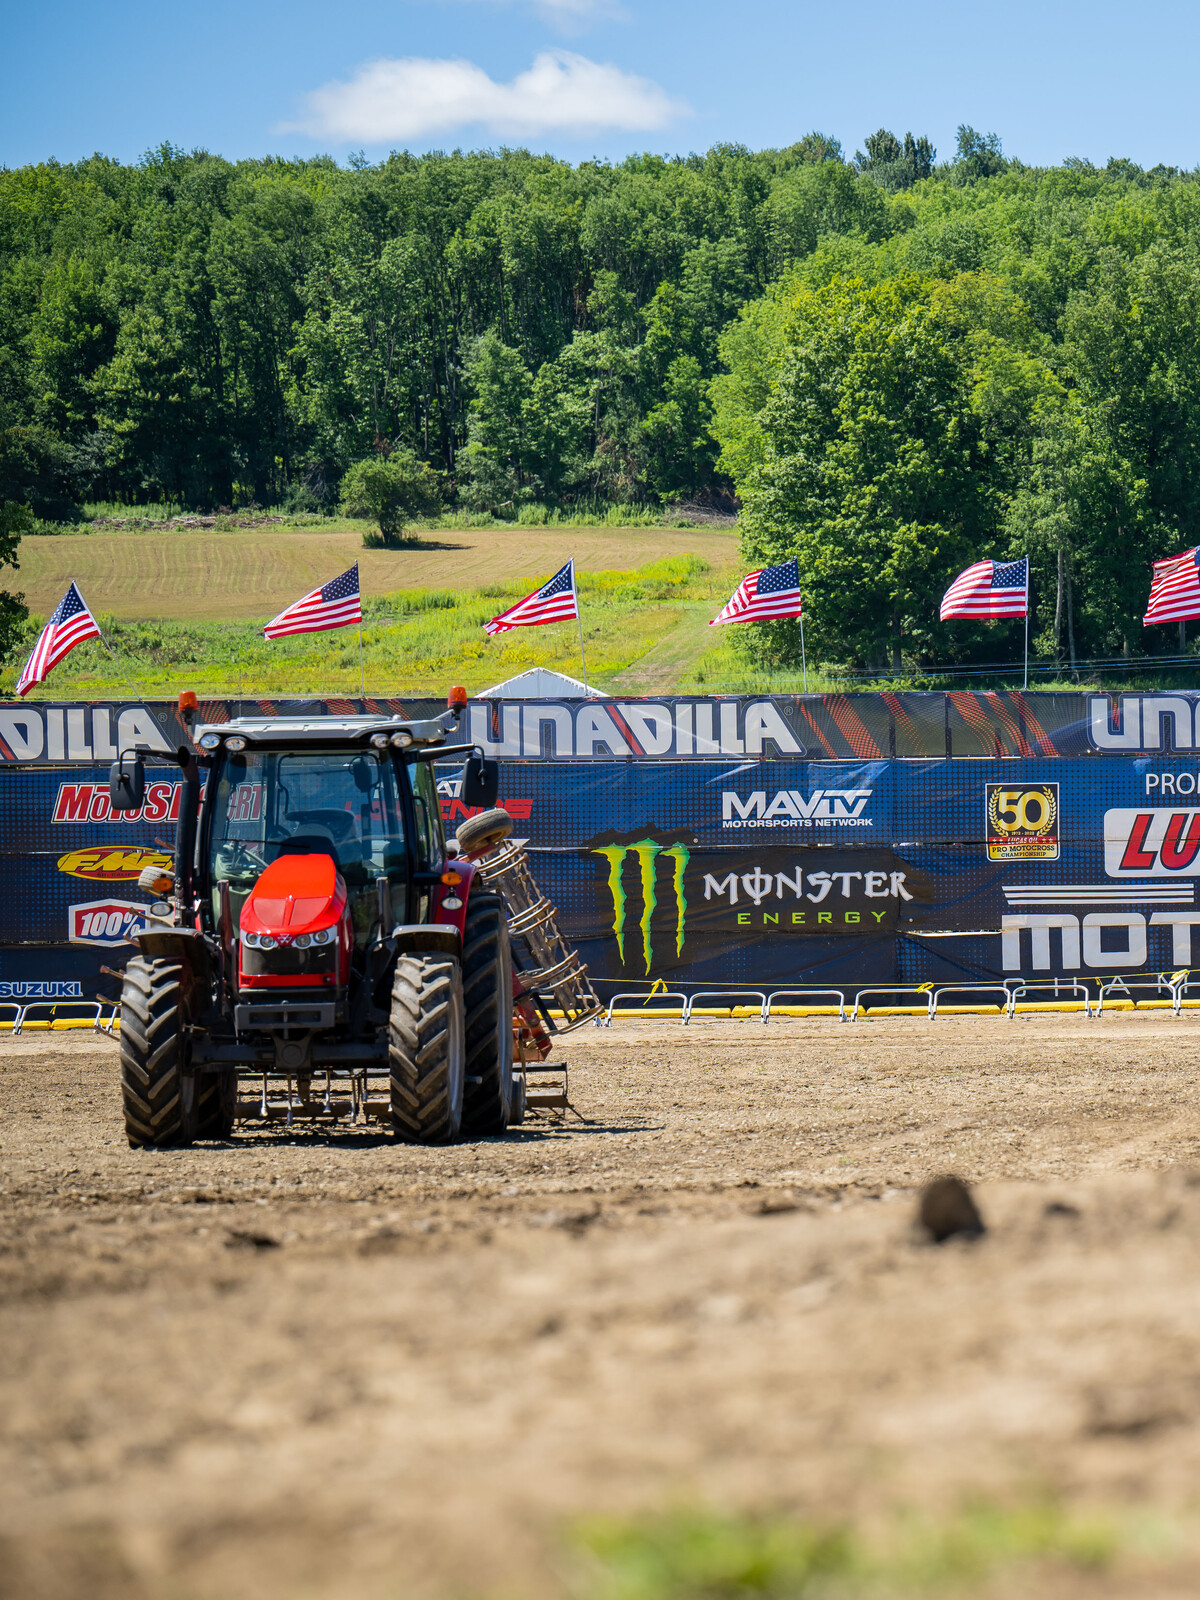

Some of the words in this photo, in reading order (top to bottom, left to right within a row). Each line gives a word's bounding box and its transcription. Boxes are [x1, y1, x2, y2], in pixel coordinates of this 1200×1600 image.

[0, 709, 176, 760] DILLA
[470, 702, 802, 756] UNADILLA
[722, 790, 873, 820] MAVTV
[997, 791, 1051, 831] 50
[722, 818, 812, 828] MOTORSPORTS
[815, 818, 873, 827] NETWORK
[59, 852, 172, 871] FMF
[703, 866, 914, 906] MONSTER
[81, 911, 141, 937] 100%
[737, 911, 887, 925] ENERGY
[0, 982, 82, 997] SUZUKI
